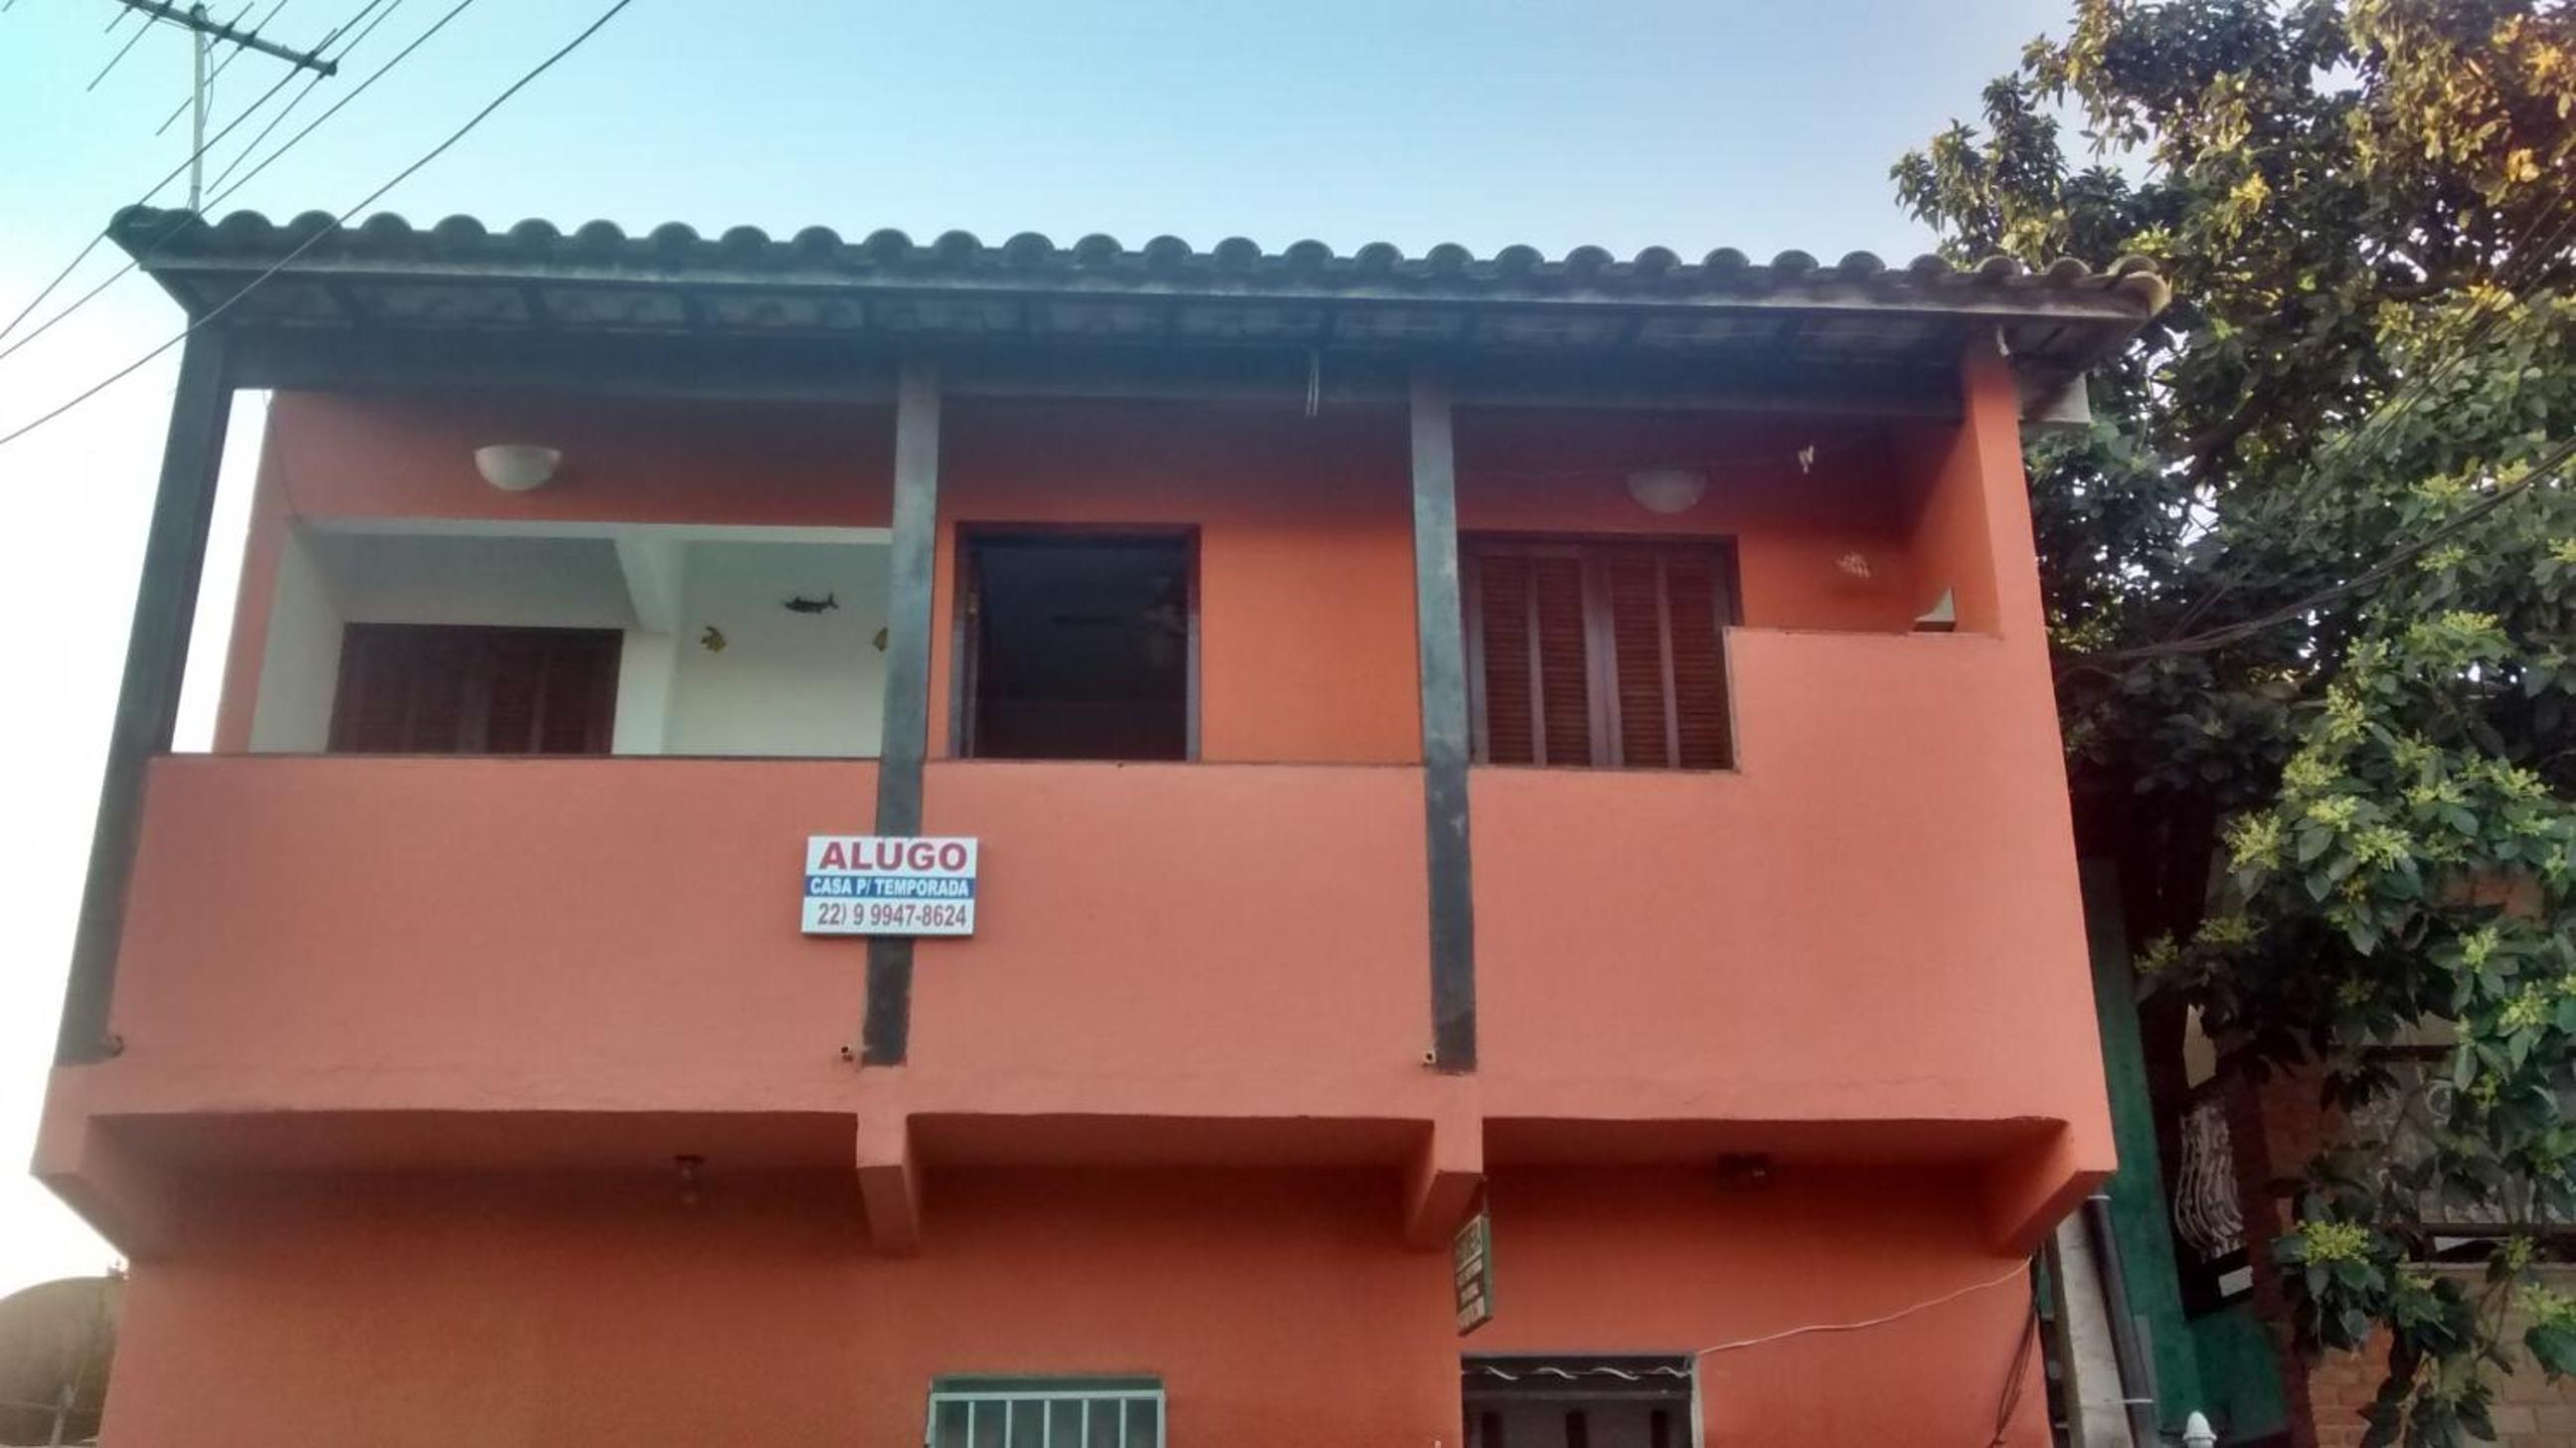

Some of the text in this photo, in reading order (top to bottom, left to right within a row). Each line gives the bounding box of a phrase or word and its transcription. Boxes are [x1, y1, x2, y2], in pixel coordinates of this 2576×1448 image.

[819, 841, 967, 871] ALUGO
[810, 877, 968, 897] CASA P/ TEMPORADA
[818, 903, 966, 927] 22) 9 9947-8624
